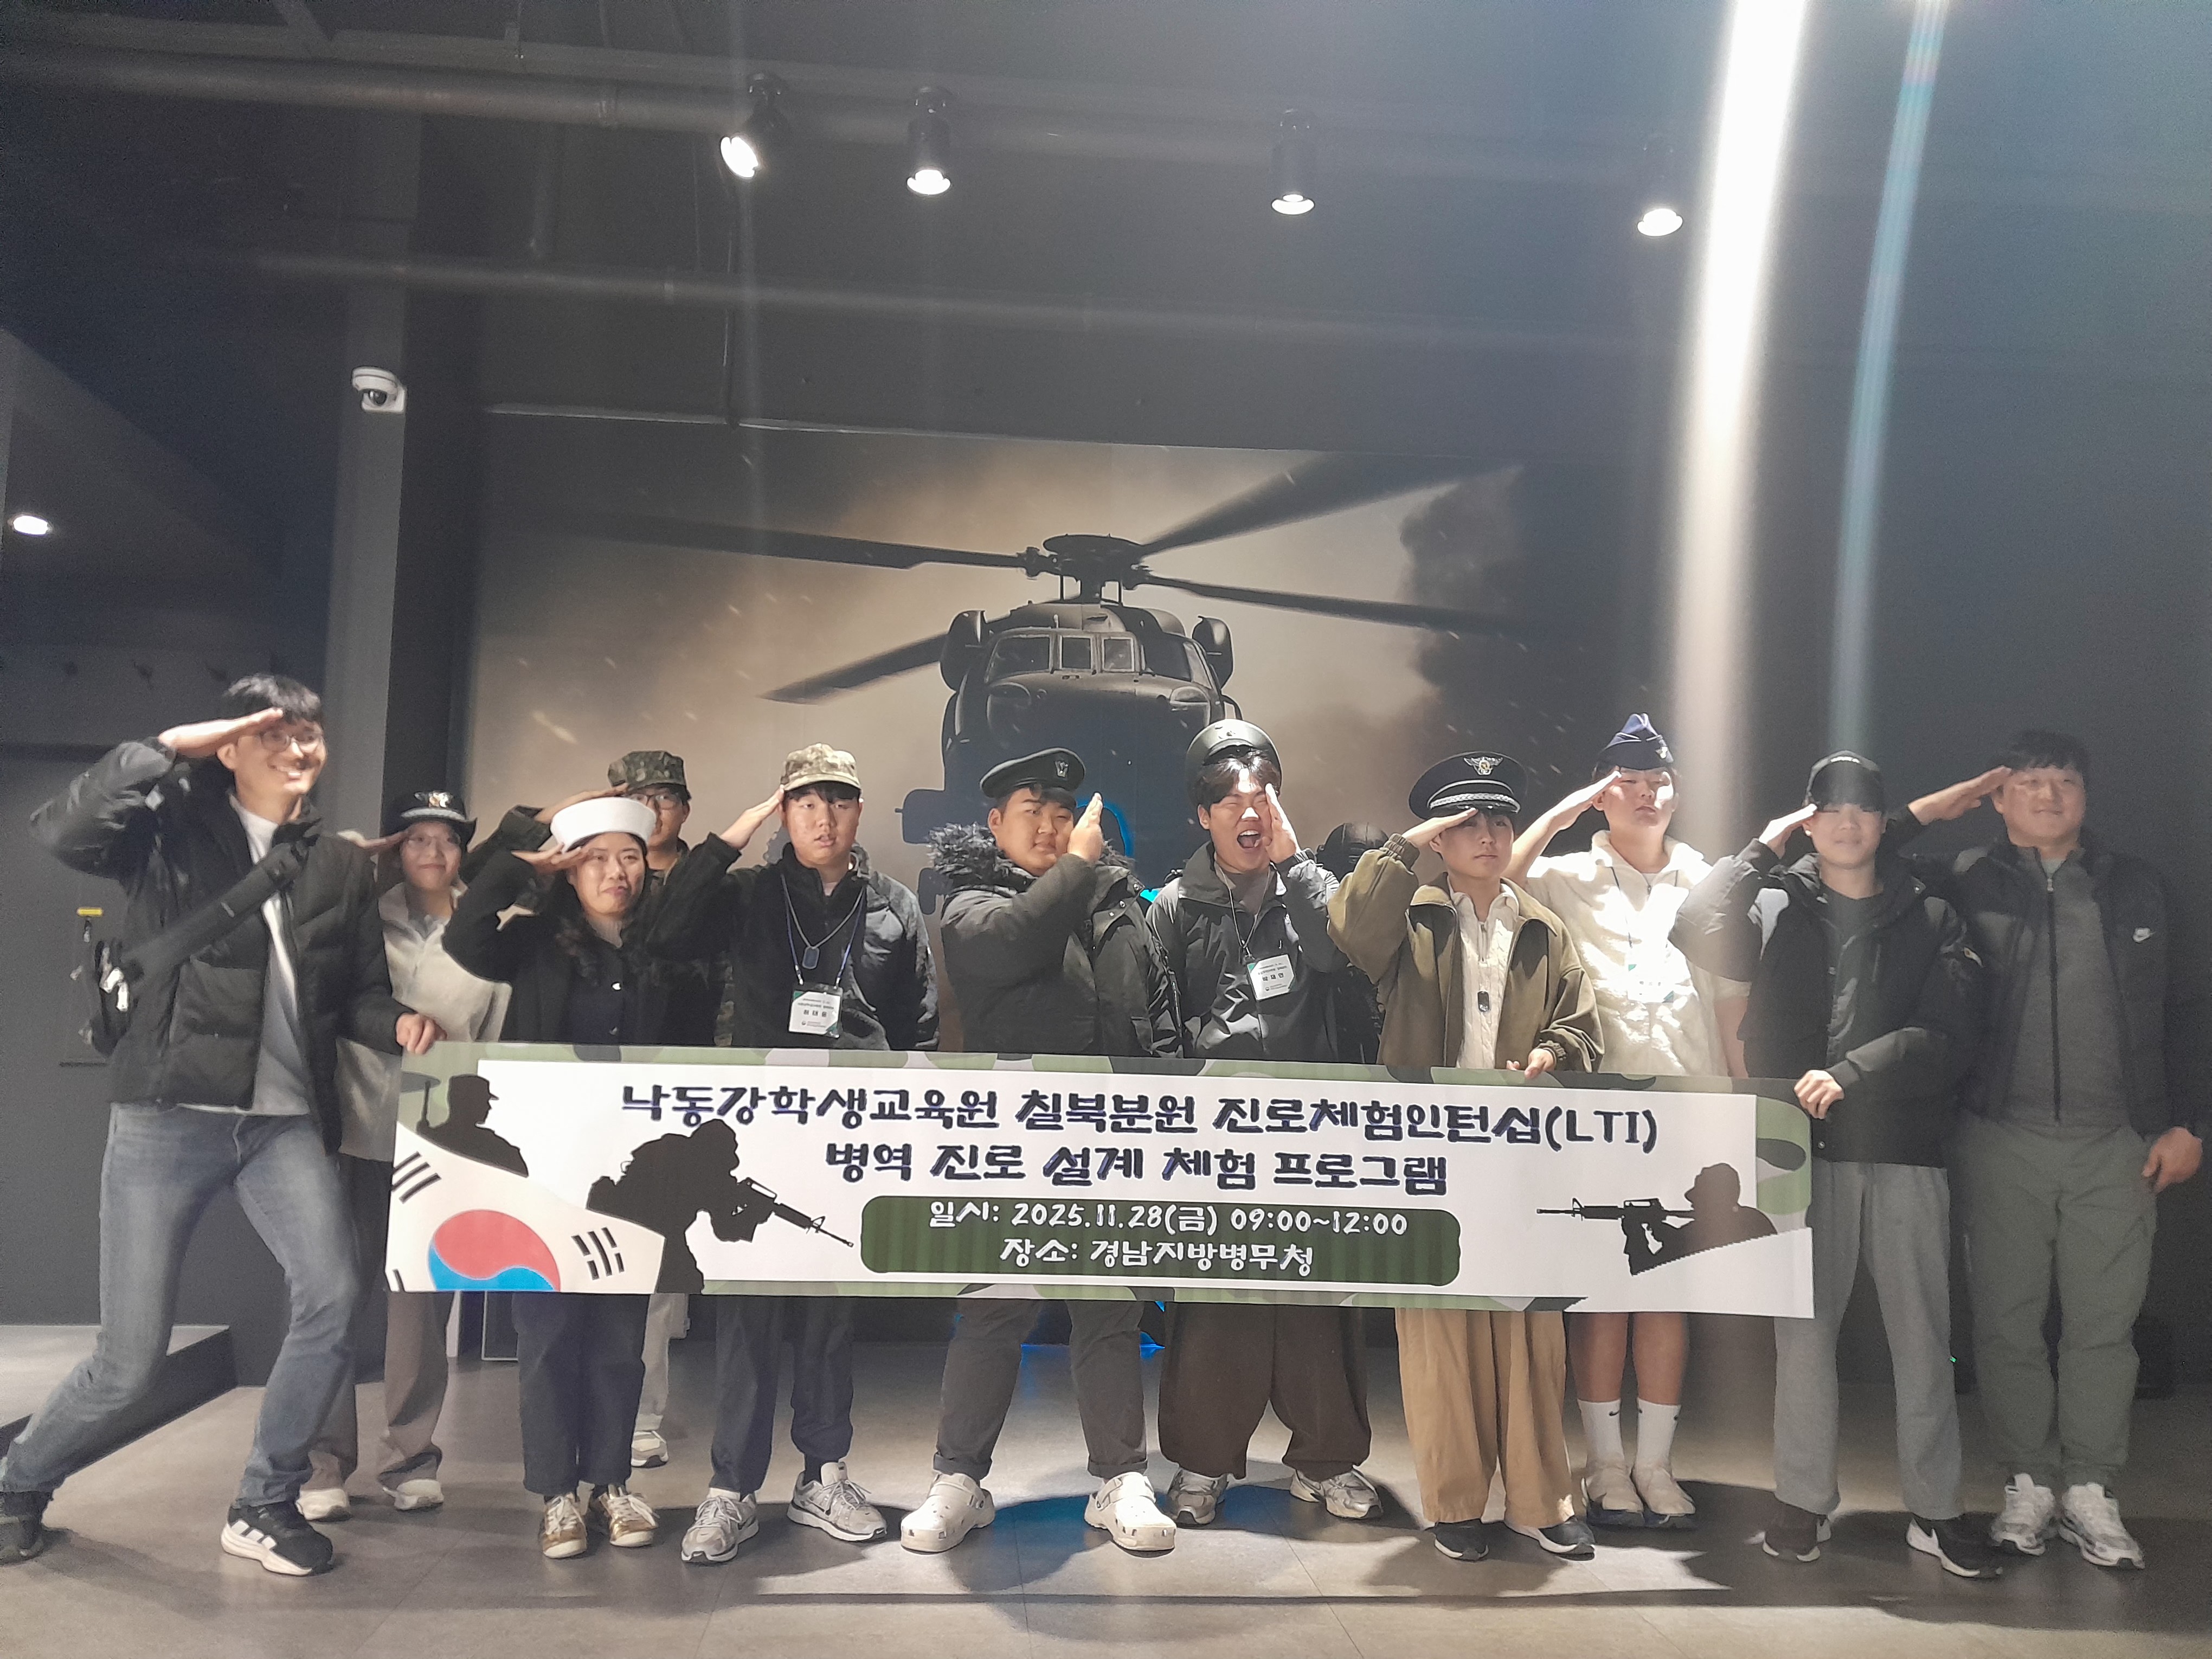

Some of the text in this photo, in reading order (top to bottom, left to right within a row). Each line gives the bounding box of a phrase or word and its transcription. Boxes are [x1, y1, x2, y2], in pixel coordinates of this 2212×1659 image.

[622, 1084, 999, 1129] 낙동강학생교육원
[1015, 1089, 1198, 1133] 칠북분원
[826, 1143, 1446, 1196] 병역 진로 설계 체험 프로그램
[929, 1201, 1407, 1236] 일시: 2025.11.28(금) 09:00~12:00
[999, 1238, 1313, 1277] 장소: 경남지방병무청
